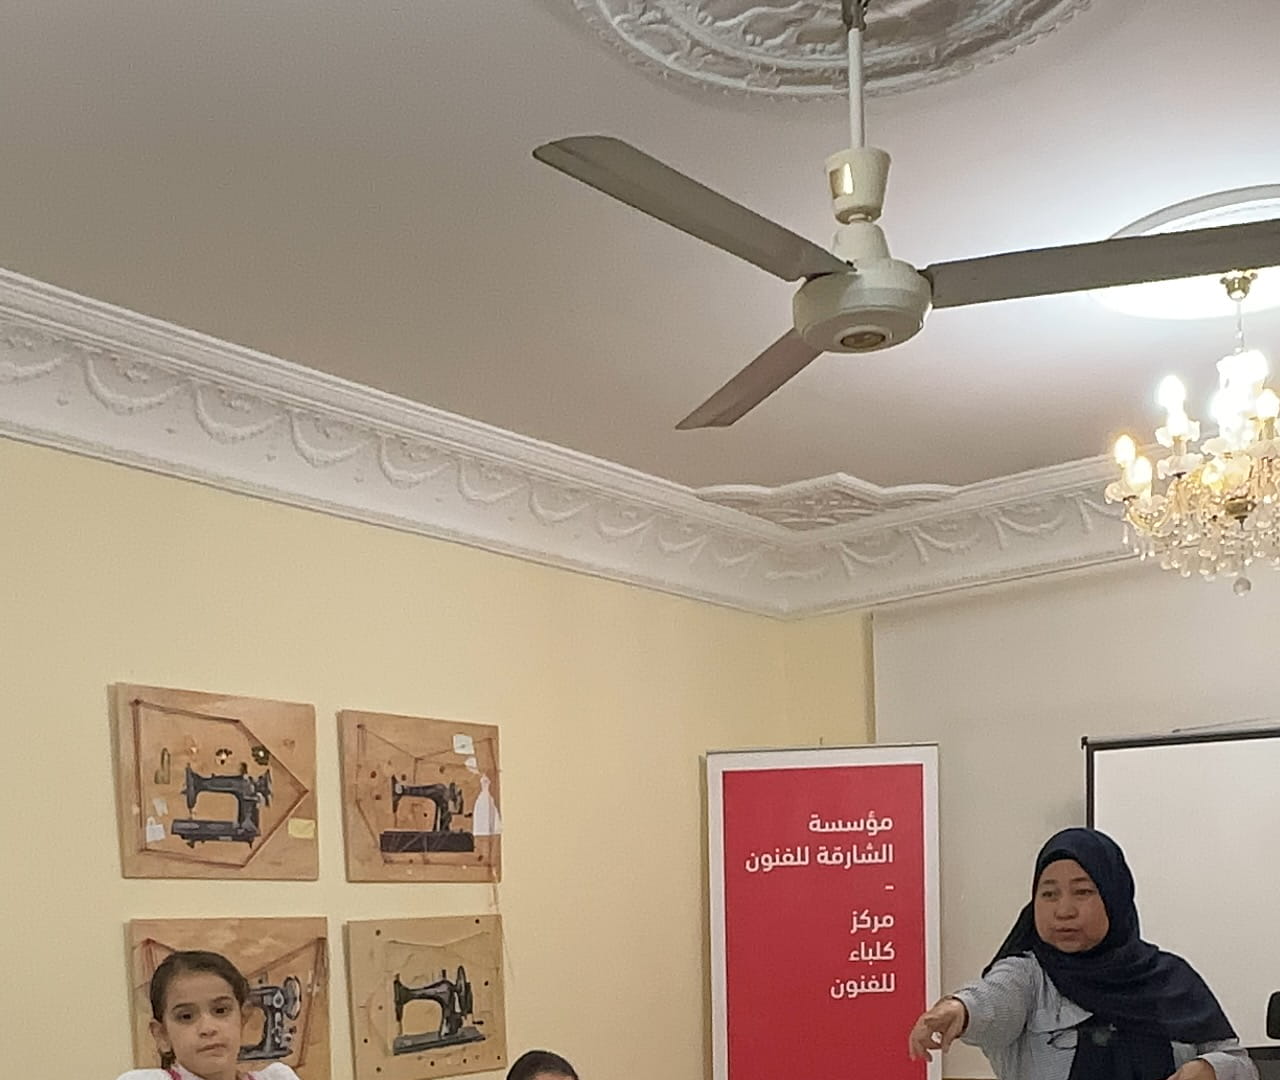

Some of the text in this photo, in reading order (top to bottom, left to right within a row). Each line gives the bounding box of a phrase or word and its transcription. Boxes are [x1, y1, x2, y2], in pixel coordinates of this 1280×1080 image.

[807, 809, 894, 837] مؤسسة
[744, 842, 894, 873] الشارقة للفنون
[849, 908, 895, 935] مركز
[848, 940, 896, 966] كلباء
[829, 972, 896, 1000] للفنون
